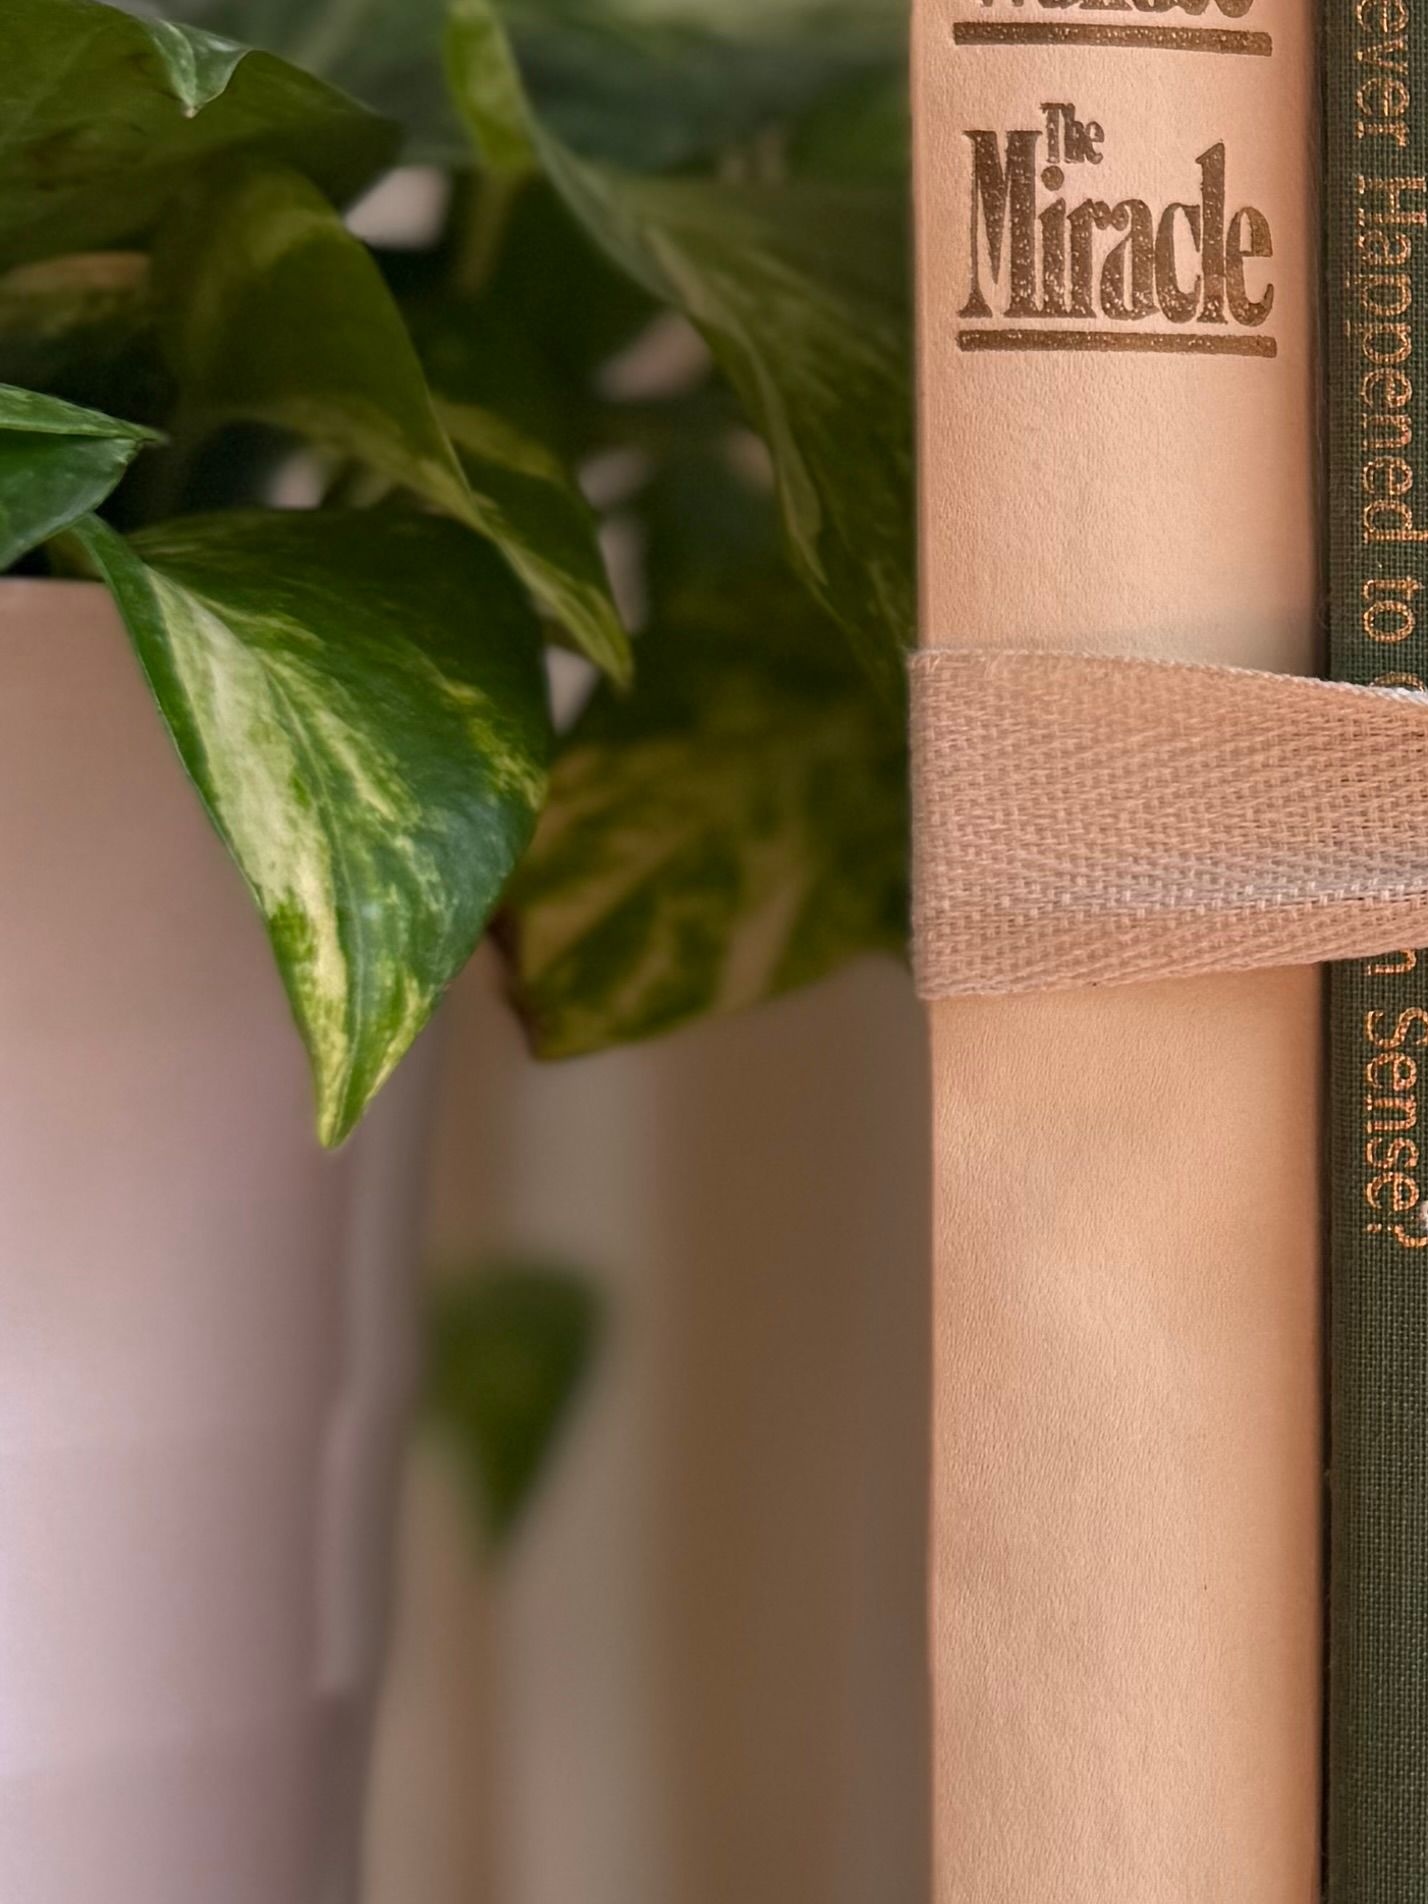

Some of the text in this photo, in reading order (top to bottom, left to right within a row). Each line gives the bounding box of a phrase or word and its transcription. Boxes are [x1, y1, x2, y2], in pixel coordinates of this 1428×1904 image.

[1040, 102, 1105, 164] The
[957, 129, 1276, 327] Miracle
[1363, 576, 1425, 644] to
